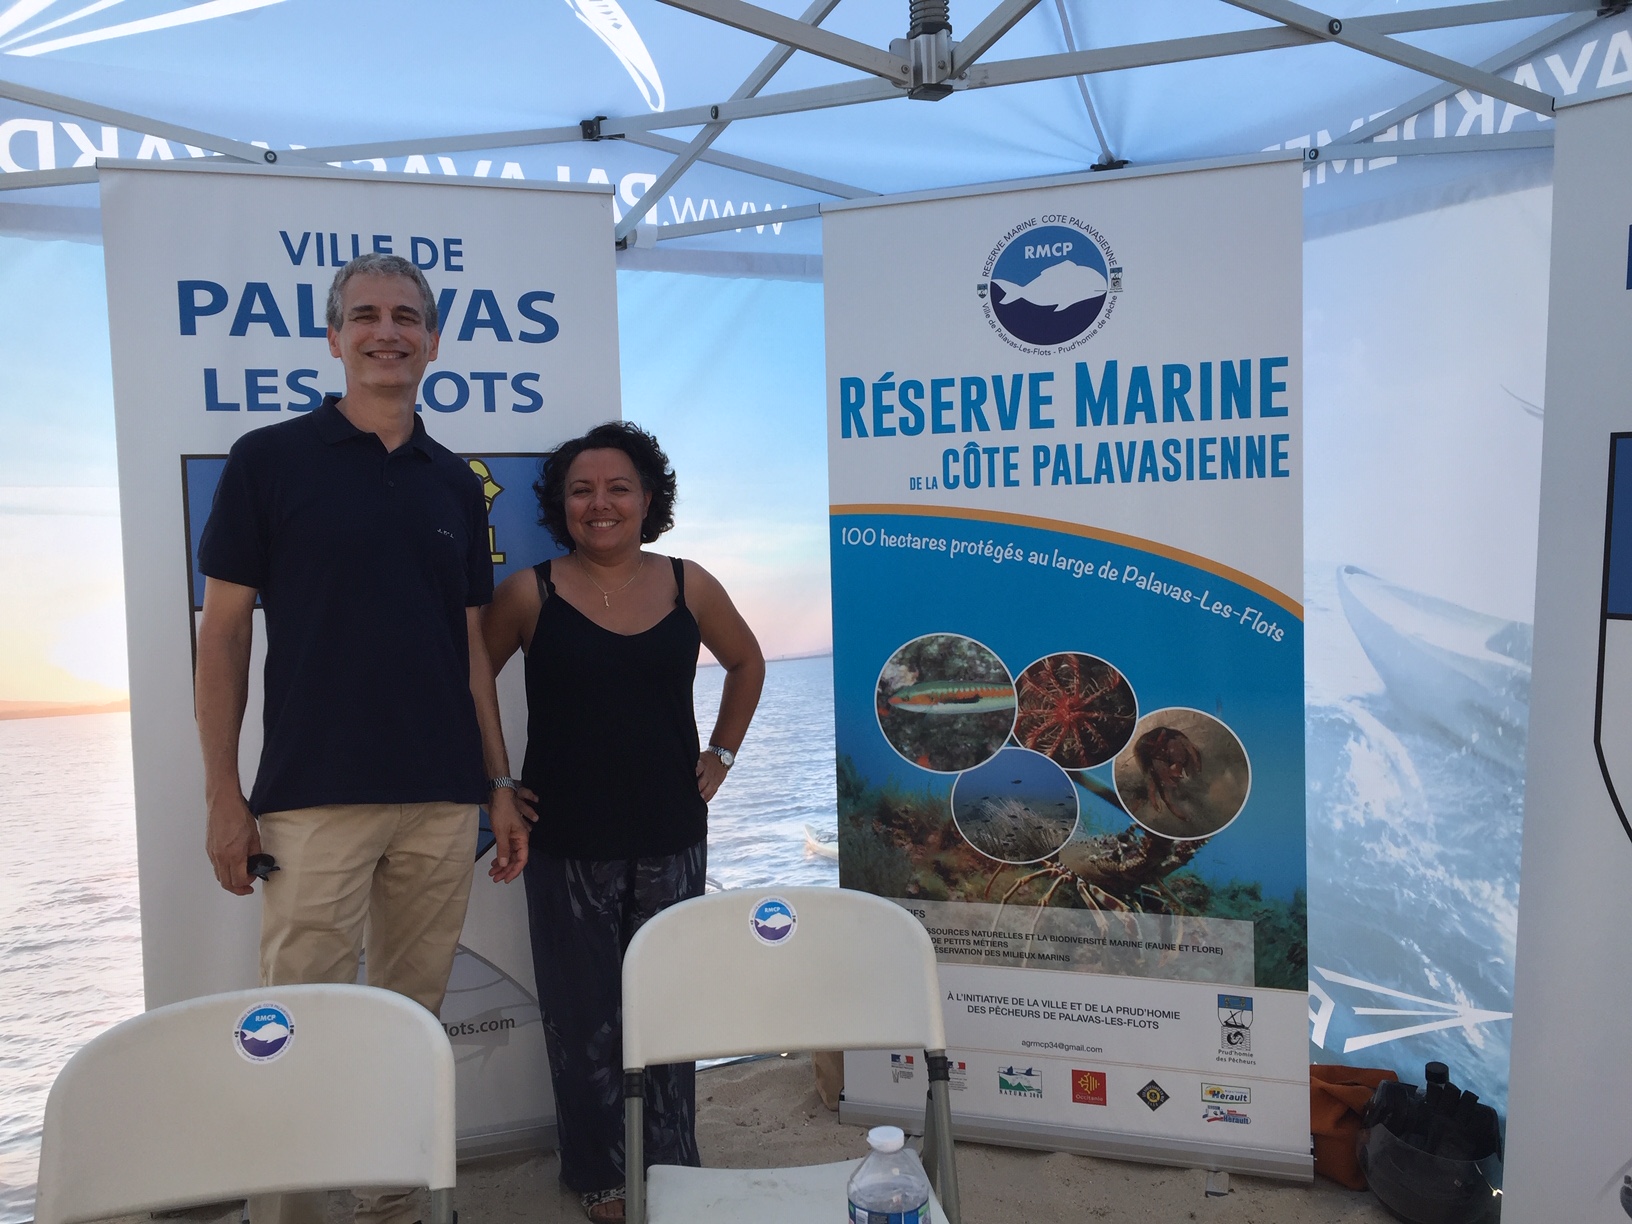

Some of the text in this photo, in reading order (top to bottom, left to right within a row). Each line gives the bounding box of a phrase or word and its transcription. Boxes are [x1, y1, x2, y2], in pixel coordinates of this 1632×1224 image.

[279, 230, 464, 272] VILLE DE
[982, 214, 1117, 277] RESERVE MARINE COTE PALAVASIENNE
[1024, 242, 1073, 259] RMCP
[177, 280, 560, 343] PALVAS
[982, 302, 991, 319] Ville
[988, 320, 997, 329] de
[995, 327, 1052, 356] Palavas-Les-Flots
[1058, 329, 1098, 354] Prud'homie
[1098, 319, 1107, 329] de
[1105, 295, 1118, 320] pêche
[203, 368, 544, 413] LES-OTS
[840, 356, 1289, 439] RÉSERVE MARINE
[909, 433, 1290, 491] DE LA CÔTE PALAVASIENNE
[841, 527, 1285, 642] 100 hectares protégés au large de Palavas-Les-Flots
[931, 937, 1009, 948] DE PETITS MÉTIERS
[971, 930, 1023, 940] NATURELLES
[1025, 933, 1035, 941] ET
[1037, 934, 1048, 942] LA
[1050, 935, 1107, 946] BIODIVERSITÉ
[1109, 939, 1142, 948] MARINE
[1145, 942, 1176, 952] (FAUNE
[1178, 944, 1189, 952] ET
[1191, 945, 1224, 956] FLORE)
[984, 949, 1001, 957] DES
[1002, 951, 1036, 960] MILIEUX
[1037, 953, 1070, 962] MARINS
[255, 1014, 276, 1022] RMCP
[947, 990, 1181, 1020] À L'INITIATIVE DE LA VILLE ET DE LA PRUD'HOMIE
[967, 1005, 1160, 1030] DES PÊCHEURS DE PALAVAS-LES-FLOTS
[1021, 1039, 1103, 1054] agrmcp34@gmail.com
